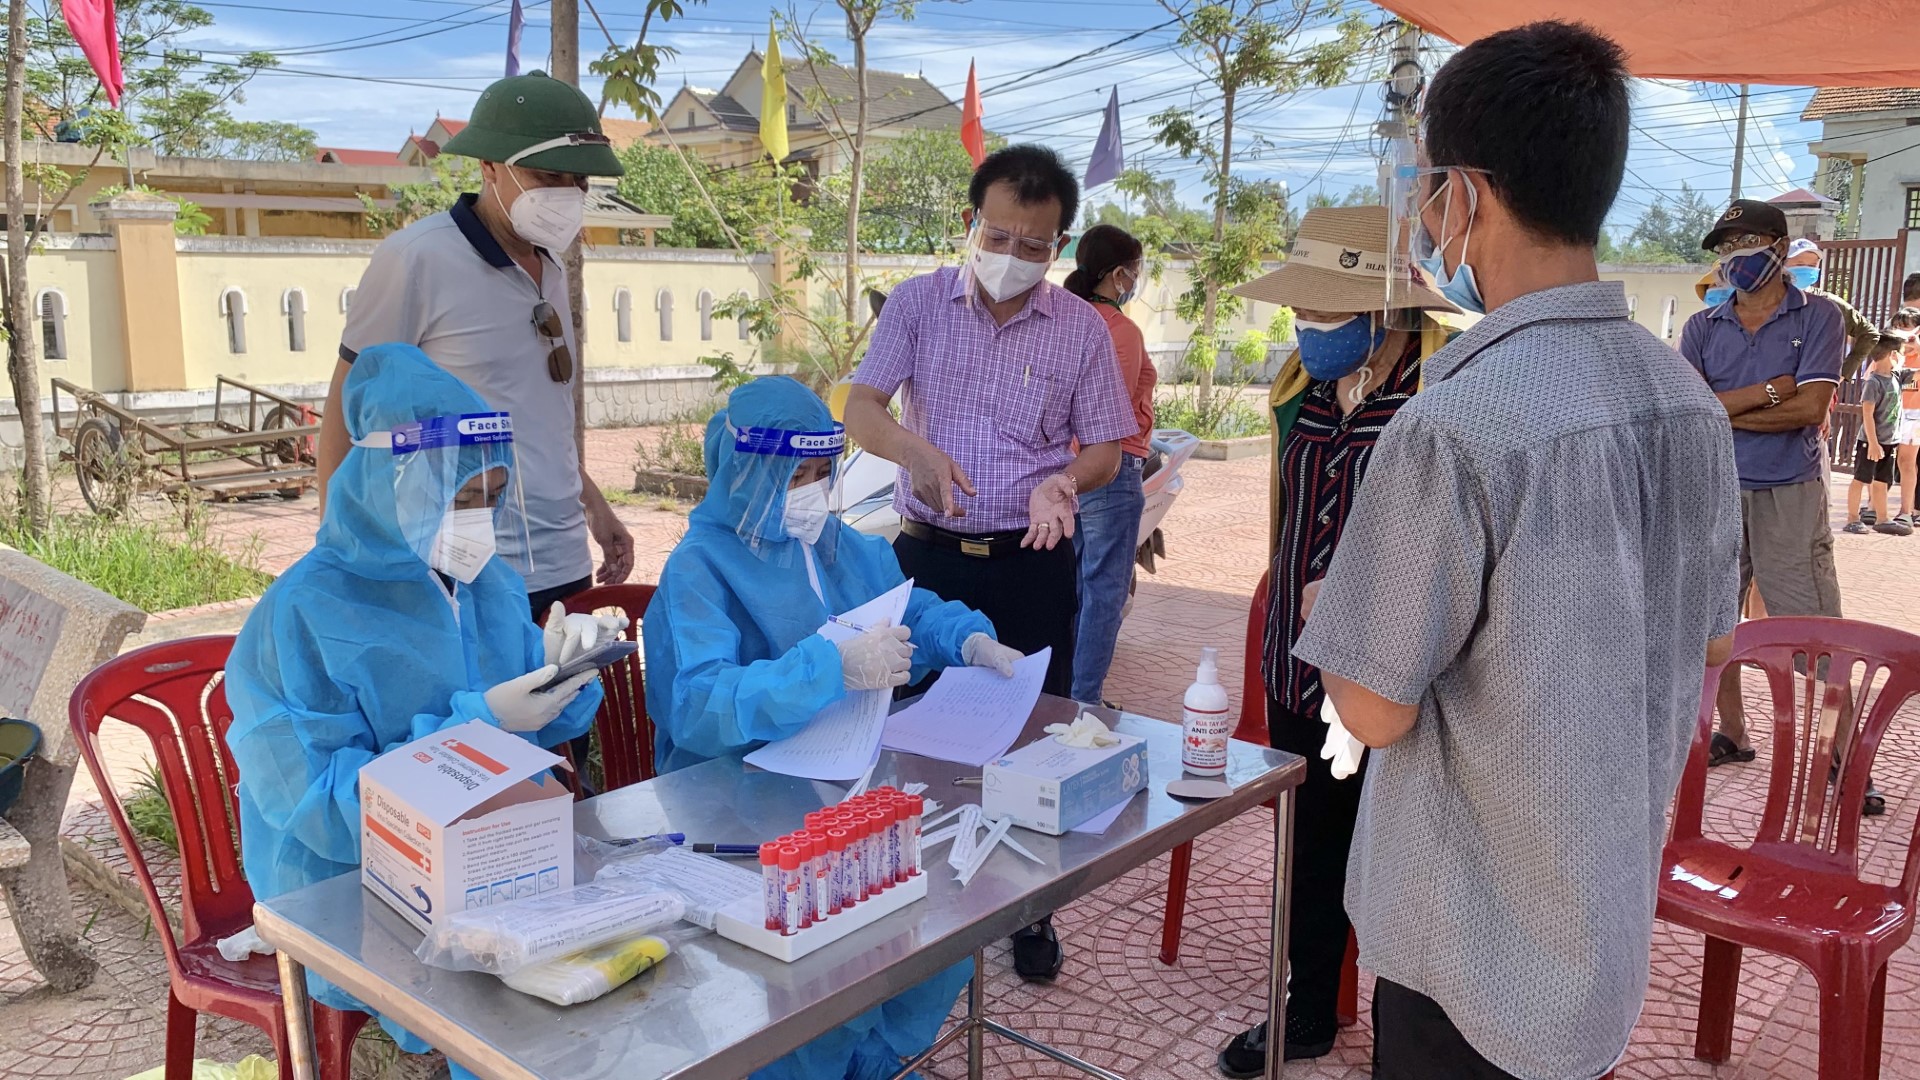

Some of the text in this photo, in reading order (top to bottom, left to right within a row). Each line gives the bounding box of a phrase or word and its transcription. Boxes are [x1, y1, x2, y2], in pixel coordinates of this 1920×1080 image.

[1365, 262, 1388, 272] BLIN
[468, 421, 498, 432] Face
[799, 437, 826, 447] Face
[1191, 727, 1208, 735] ANTI
[437, 763, 480, 791] Disposable
[377, 794, 410, 828] Disposable
[463, 827, 491, 836] Instruction
